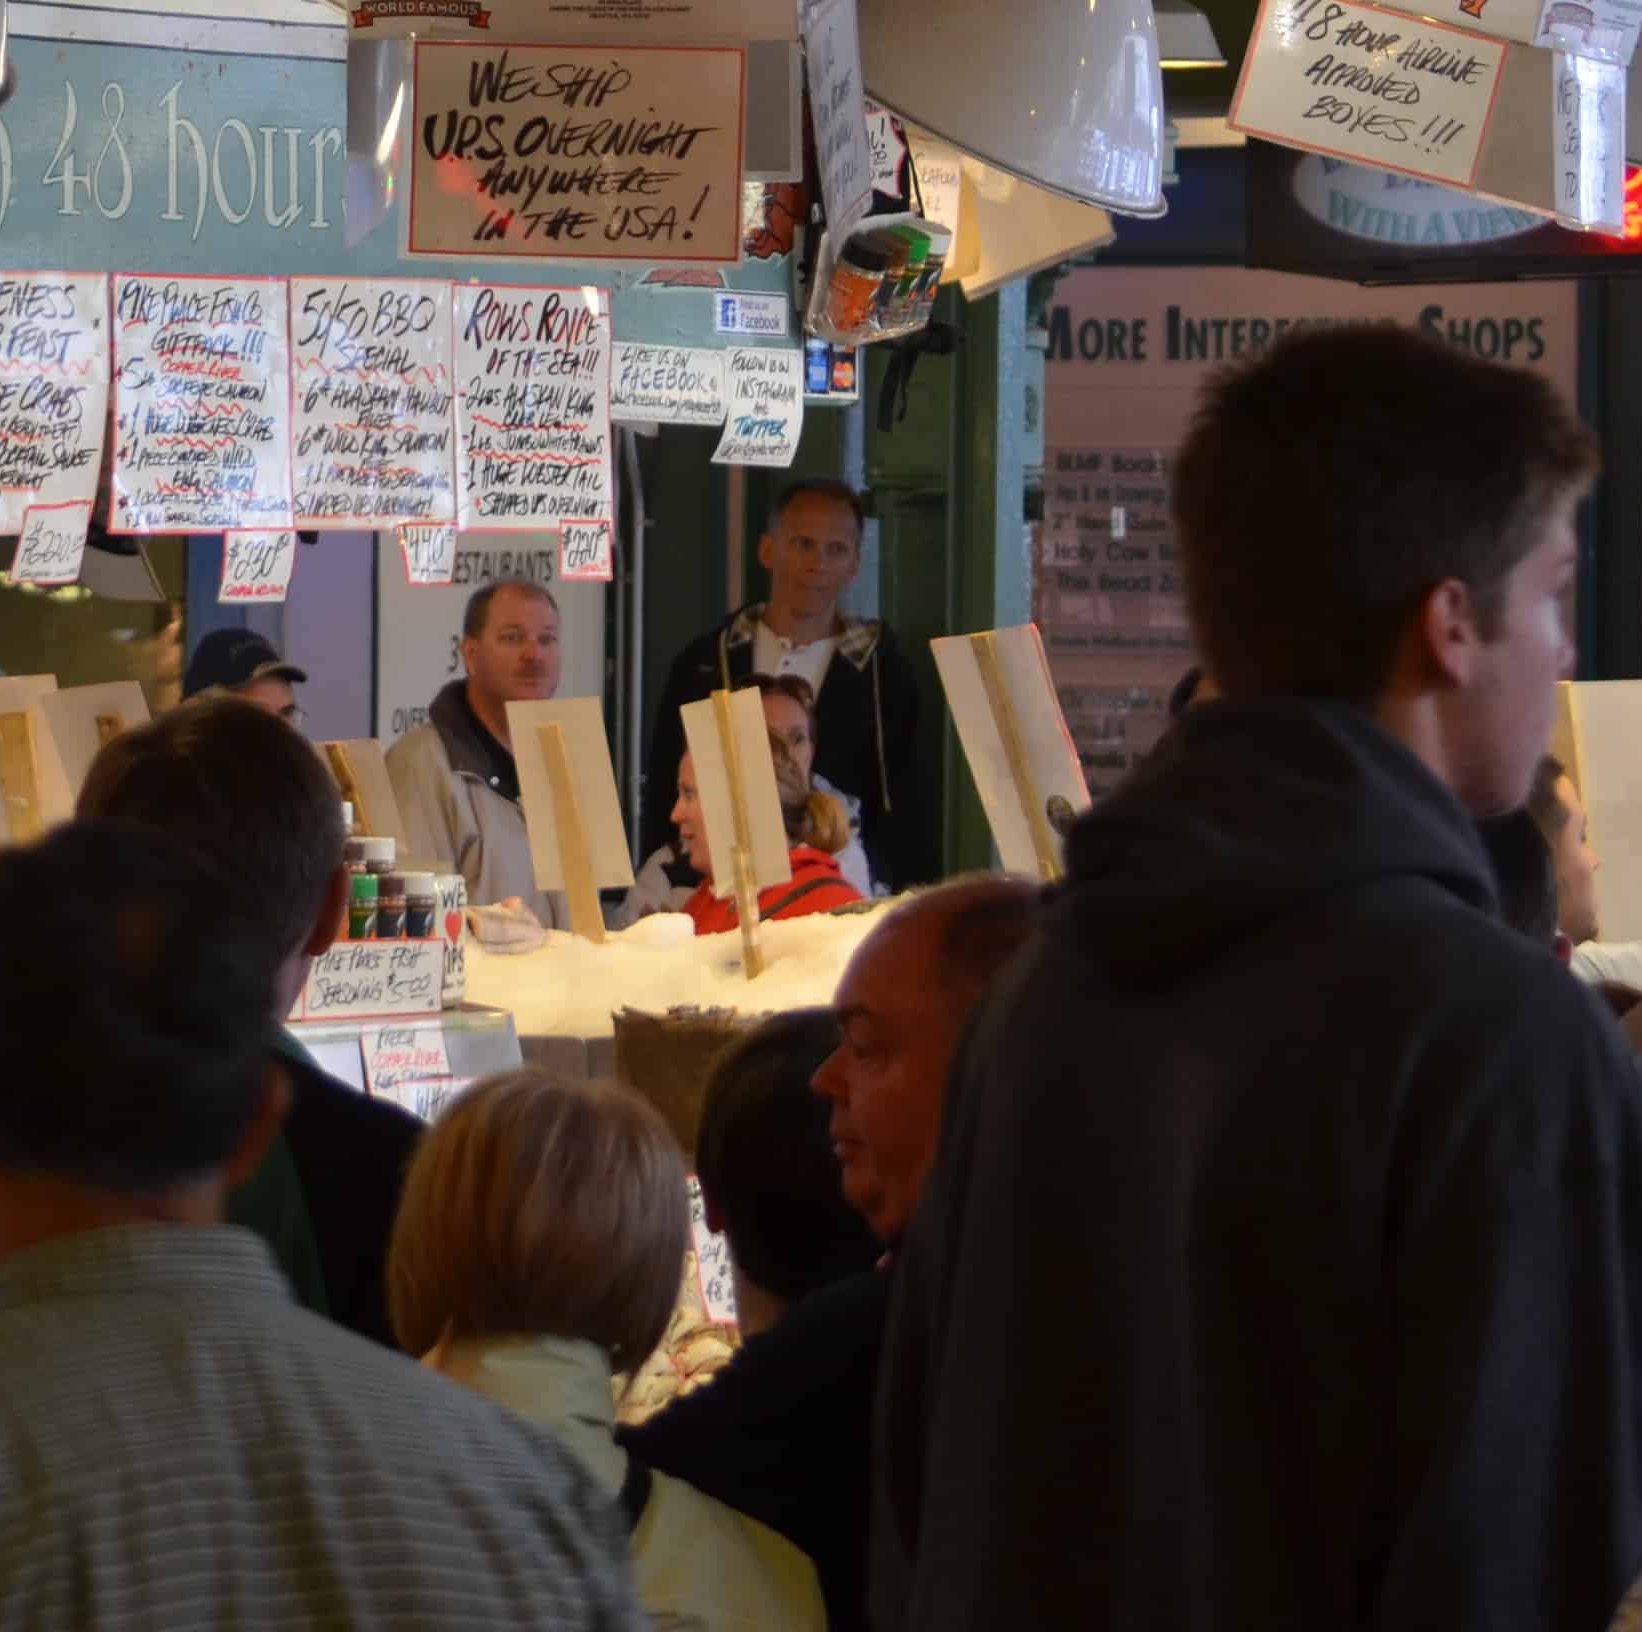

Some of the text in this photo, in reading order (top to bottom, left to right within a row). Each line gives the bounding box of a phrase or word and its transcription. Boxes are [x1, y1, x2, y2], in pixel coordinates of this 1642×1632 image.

[417, 0, 480, 18] FAMOUS
[1335, 20, 1488, 85] HOUR AIRLINE
[468, 50, 632, 106] WE SHIP
[1304, 53, 1421, 105] APPROVED
[42, 79, 136, 222] 48
[513, 105, 719, 160] OVERNIGHT
[477, 156, 682, 211] ANYWHERE
[473, 185, 711, 243] IN THE USA!
[1328, 189, 1448, 243] WITH A
[371, 289, 437, 338] BBQ
[535, 292, 610, 353] ROYCE
[740, 311, 781, 331] Facebook
[1036, 304, 1148, 361] MORE
[1418, 303, 1546, 360] SHOPS
[6, 319, 83, 363] FEAST
[332, 343, 417, 374] SPECIAL
[486, 347, 549, 378] OF THE
[19, 373, 89, 419] CRABS
[330, 380, 401, 411] ALASKAN
[502, 383, 566, 410] ALASKAN
[565, 385, 596, 418] KING
[620, 366, 707, 394] FACEBOOK
[734, 376, 797, 404] INSTAGRAM
[388, 426, 450, 455] SALMON
[570, 463, 603, 492] TAIL
